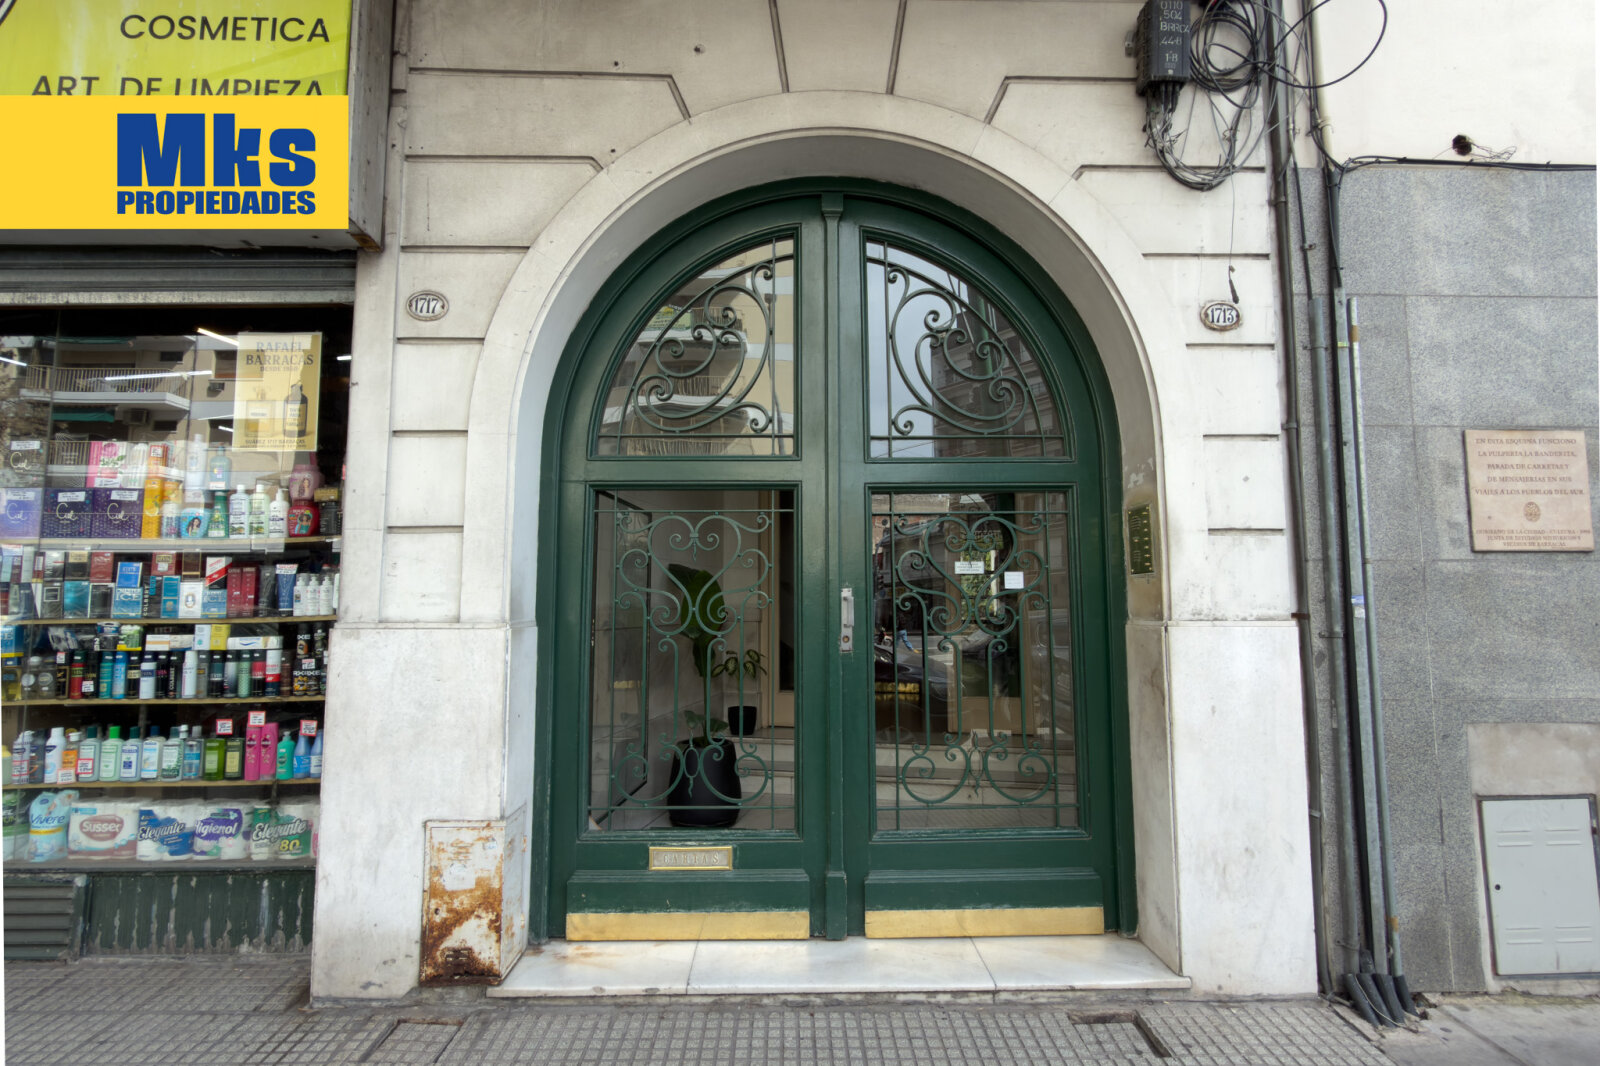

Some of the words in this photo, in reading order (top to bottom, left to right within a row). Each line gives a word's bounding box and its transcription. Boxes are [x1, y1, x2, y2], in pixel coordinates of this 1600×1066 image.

[120, 14, 331, 43] COSMETICA
[415, 297, 439, 314] 1717
[1210, 307, 1235, 324] 1713
[246, 354, 314, 365] BARRACAS
[30, 813, 66, 825] Vivere
[137, 821, 186, 843] Elegante
[252, 818, 308, 843] Elegante
